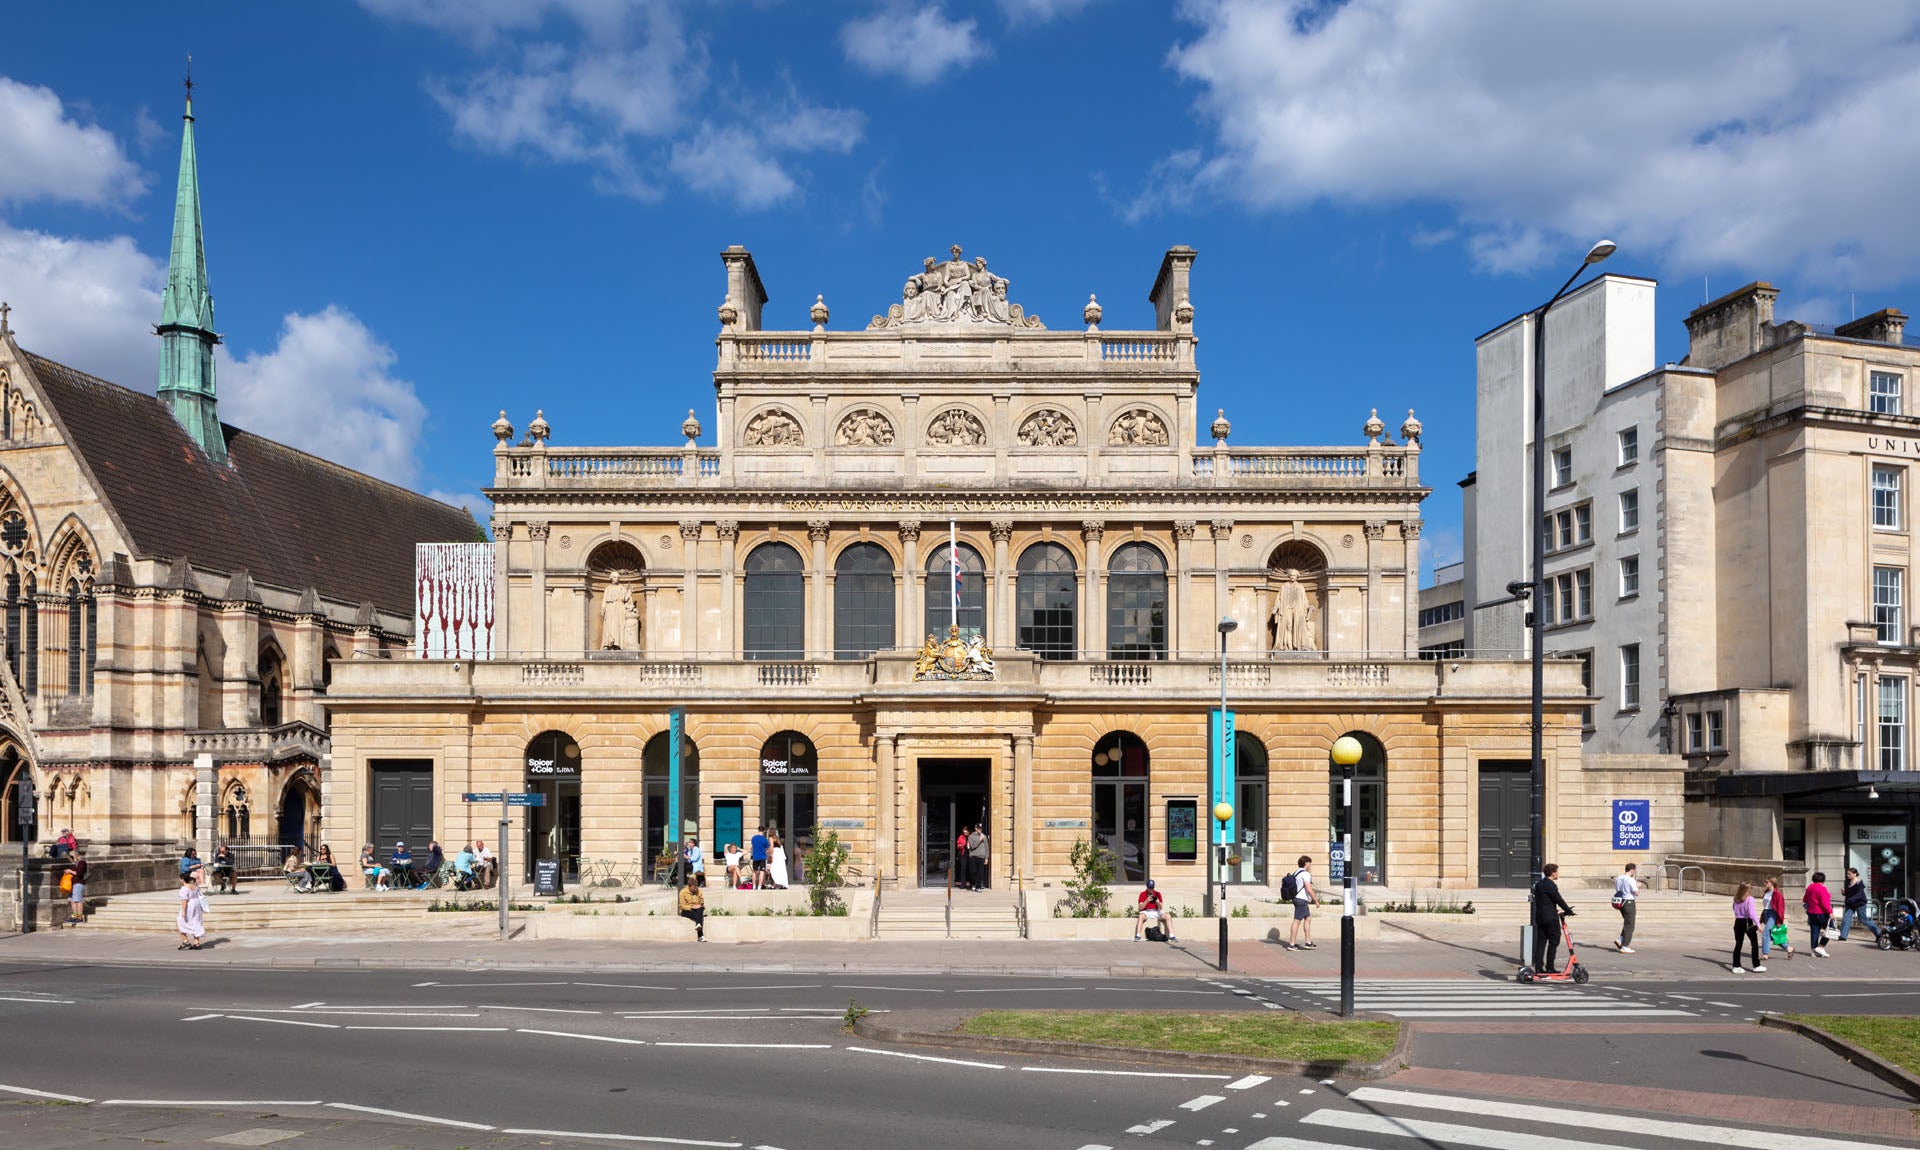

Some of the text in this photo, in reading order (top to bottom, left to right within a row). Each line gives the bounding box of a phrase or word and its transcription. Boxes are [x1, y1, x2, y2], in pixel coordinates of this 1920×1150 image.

[788, 500, 1122, 511] ROYAL WEST OF ENGLAND ACADEMY OF ART
[528, 759, 554, 768] Spicer
[762, 759, 788, 768] Spicer
[765, 766, 788, 774] +Cole
